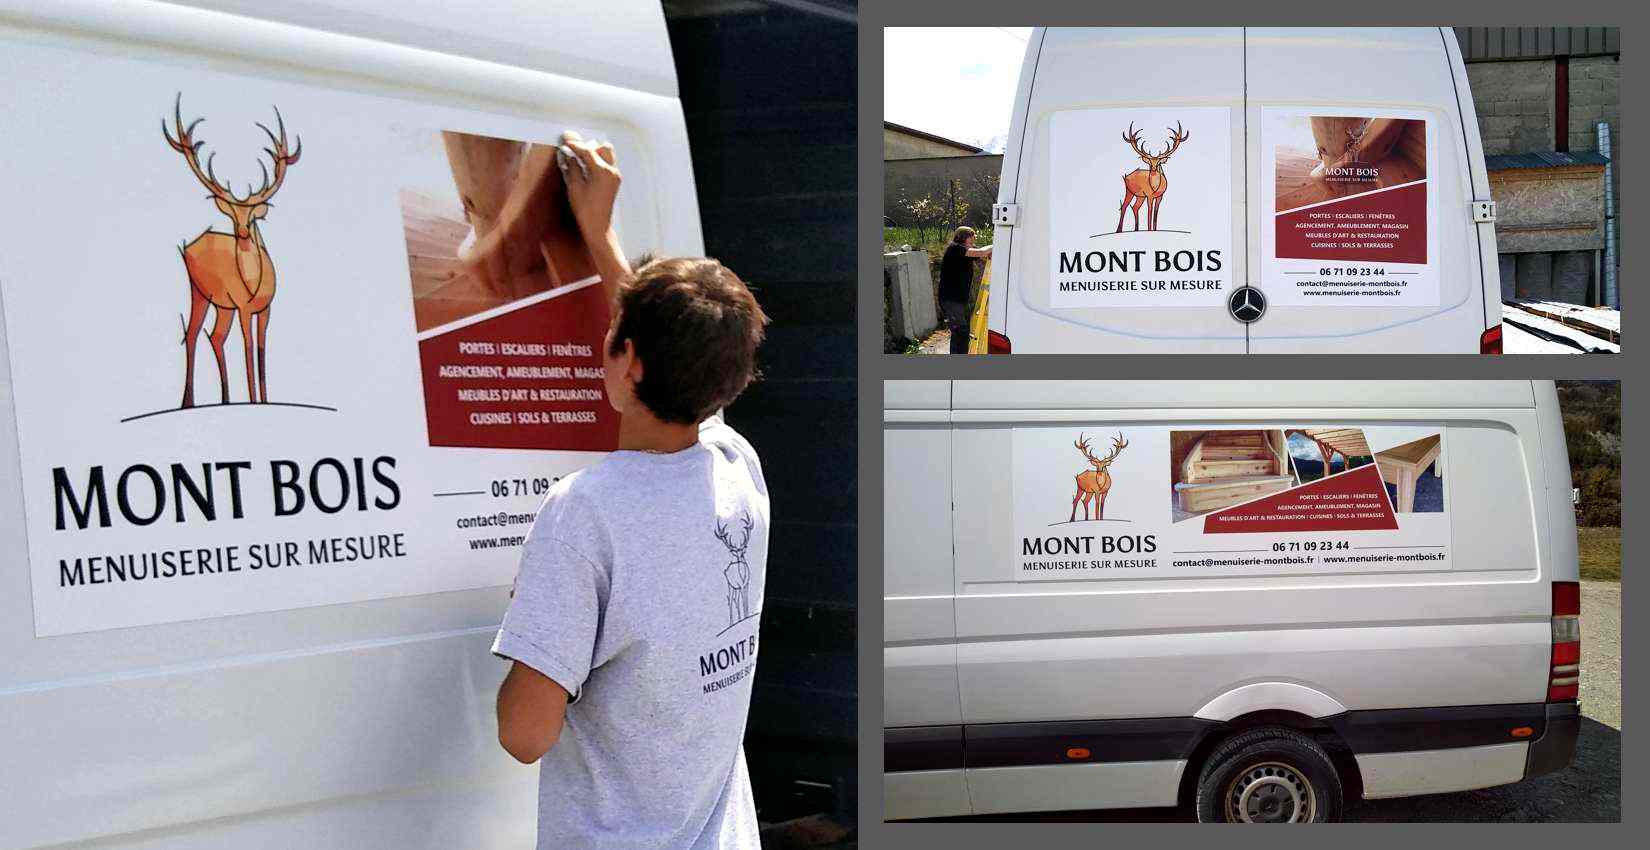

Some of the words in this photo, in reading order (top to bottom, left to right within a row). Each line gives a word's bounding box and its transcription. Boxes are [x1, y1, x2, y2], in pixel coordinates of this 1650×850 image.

[1325, 167, 1355, 176] MONT
[1356, 168, 1379, 176] BOIS
[1059, 251, 1146, 273] MONT
[1155, 250, 1222, 272] BOIS
[1320, 268, 1331, 276] 06
[1334, 268, 1343, 276] 71
[1346, 268, 1358, 276] 09
[1360, 268, 1370, 276] 23
[1373, 268, 1384, 276] 44
[1059, 281, 1137, 292] MENUISERIE
[1141, 280, 1167, 291] SUR
[1170, 280, 1222, 291] MESURE
[459, 342, 494, 354] PORTES
[501, 343, 546, 356] ESCALIERS
[439, 366, 505, 379] AGENCEMENT,
[506, 366, 573, 379] AMEUBLEMENT,
[458, 389, 500, 401] MEUBLES
[502, 389, 528, 401] D'ART
[530, 389, 538, 401] &
[540, 389, 602, 401] RESTAURATION
[470, 412, 512, 425] CUISINES
[518, 412, 540, 424] SOLS
[541, 412, 549, 424] &
[551, 411, 596, 423] TERRASSES
[51, 461, 252, 531] MONT
[270, 455, 401, 516] BOIS
[491, 480, 509, 497] 06
[513, 479, 528, 496] 71
[533, 478, 549, 495] 09
[1023, 537, 1094, 555] MONT
[1101, 535, 1157, 553] BOIS
[1272, 542, 1285, 551] 06
[1289, 542, 1300, 551] 71
[1304, 542, 1317, 551] 09
[1320, 542, 1332, 550] 23
[1336, 541, 1349, 550] 44
[59, 546, 242, 588] MENUISERIE
[249, 541, 302, 570] SUR
[308, 533, 407, 565] MESURE
[1023, 561, 1088, 571] MENUISERIE
[1091, 560, 1112, 569] SUR
[1114, 559, 1157, 568] MESURE
[1172, 556, 1314, 567] contact@menuiserie-montbois.fr
[1323, 553, 1445, 564] www.menuiserie-montbois.fr
[700, 639, 747, 676] MONT
